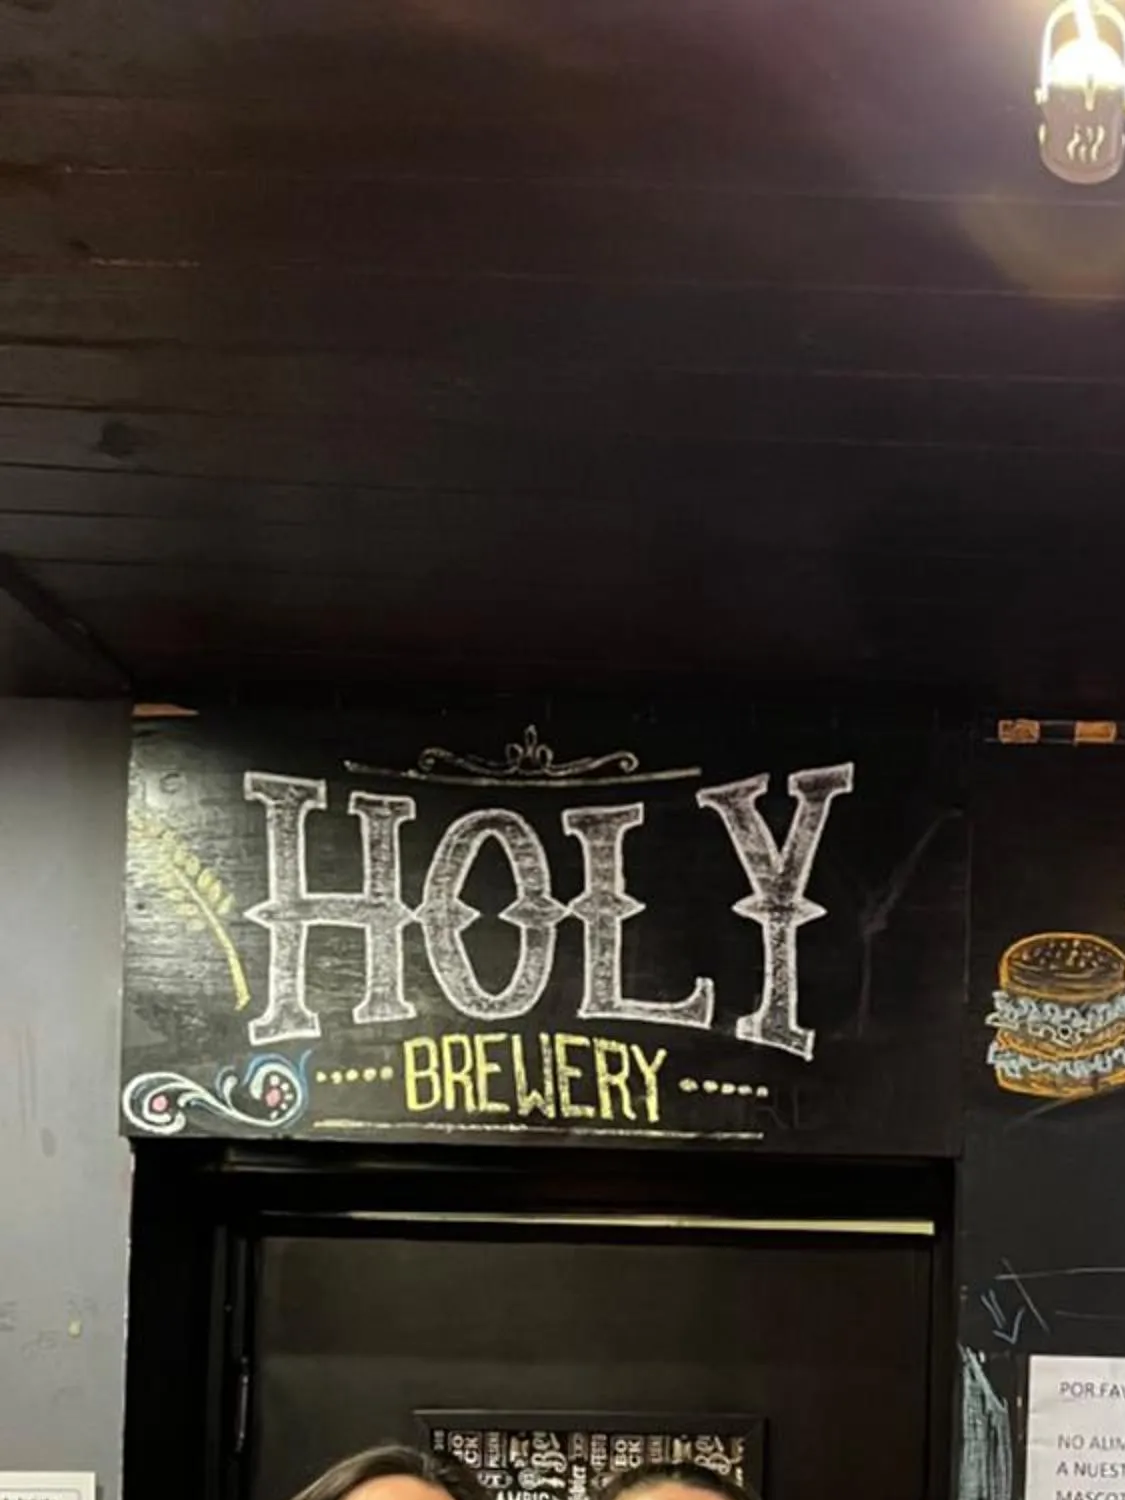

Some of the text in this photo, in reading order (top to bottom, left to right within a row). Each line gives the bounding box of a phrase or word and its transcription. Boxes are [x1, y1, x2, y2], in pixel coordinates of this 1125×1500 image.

[243, 761, 855, 1061] HOLY
[404, 1032, 667, 1122] BREWERY
[1060, 1381, 1095, 1398] POR
[1057, 1434, 1085, 1450] NO
[1056, 1461, 1069, 1476] A
